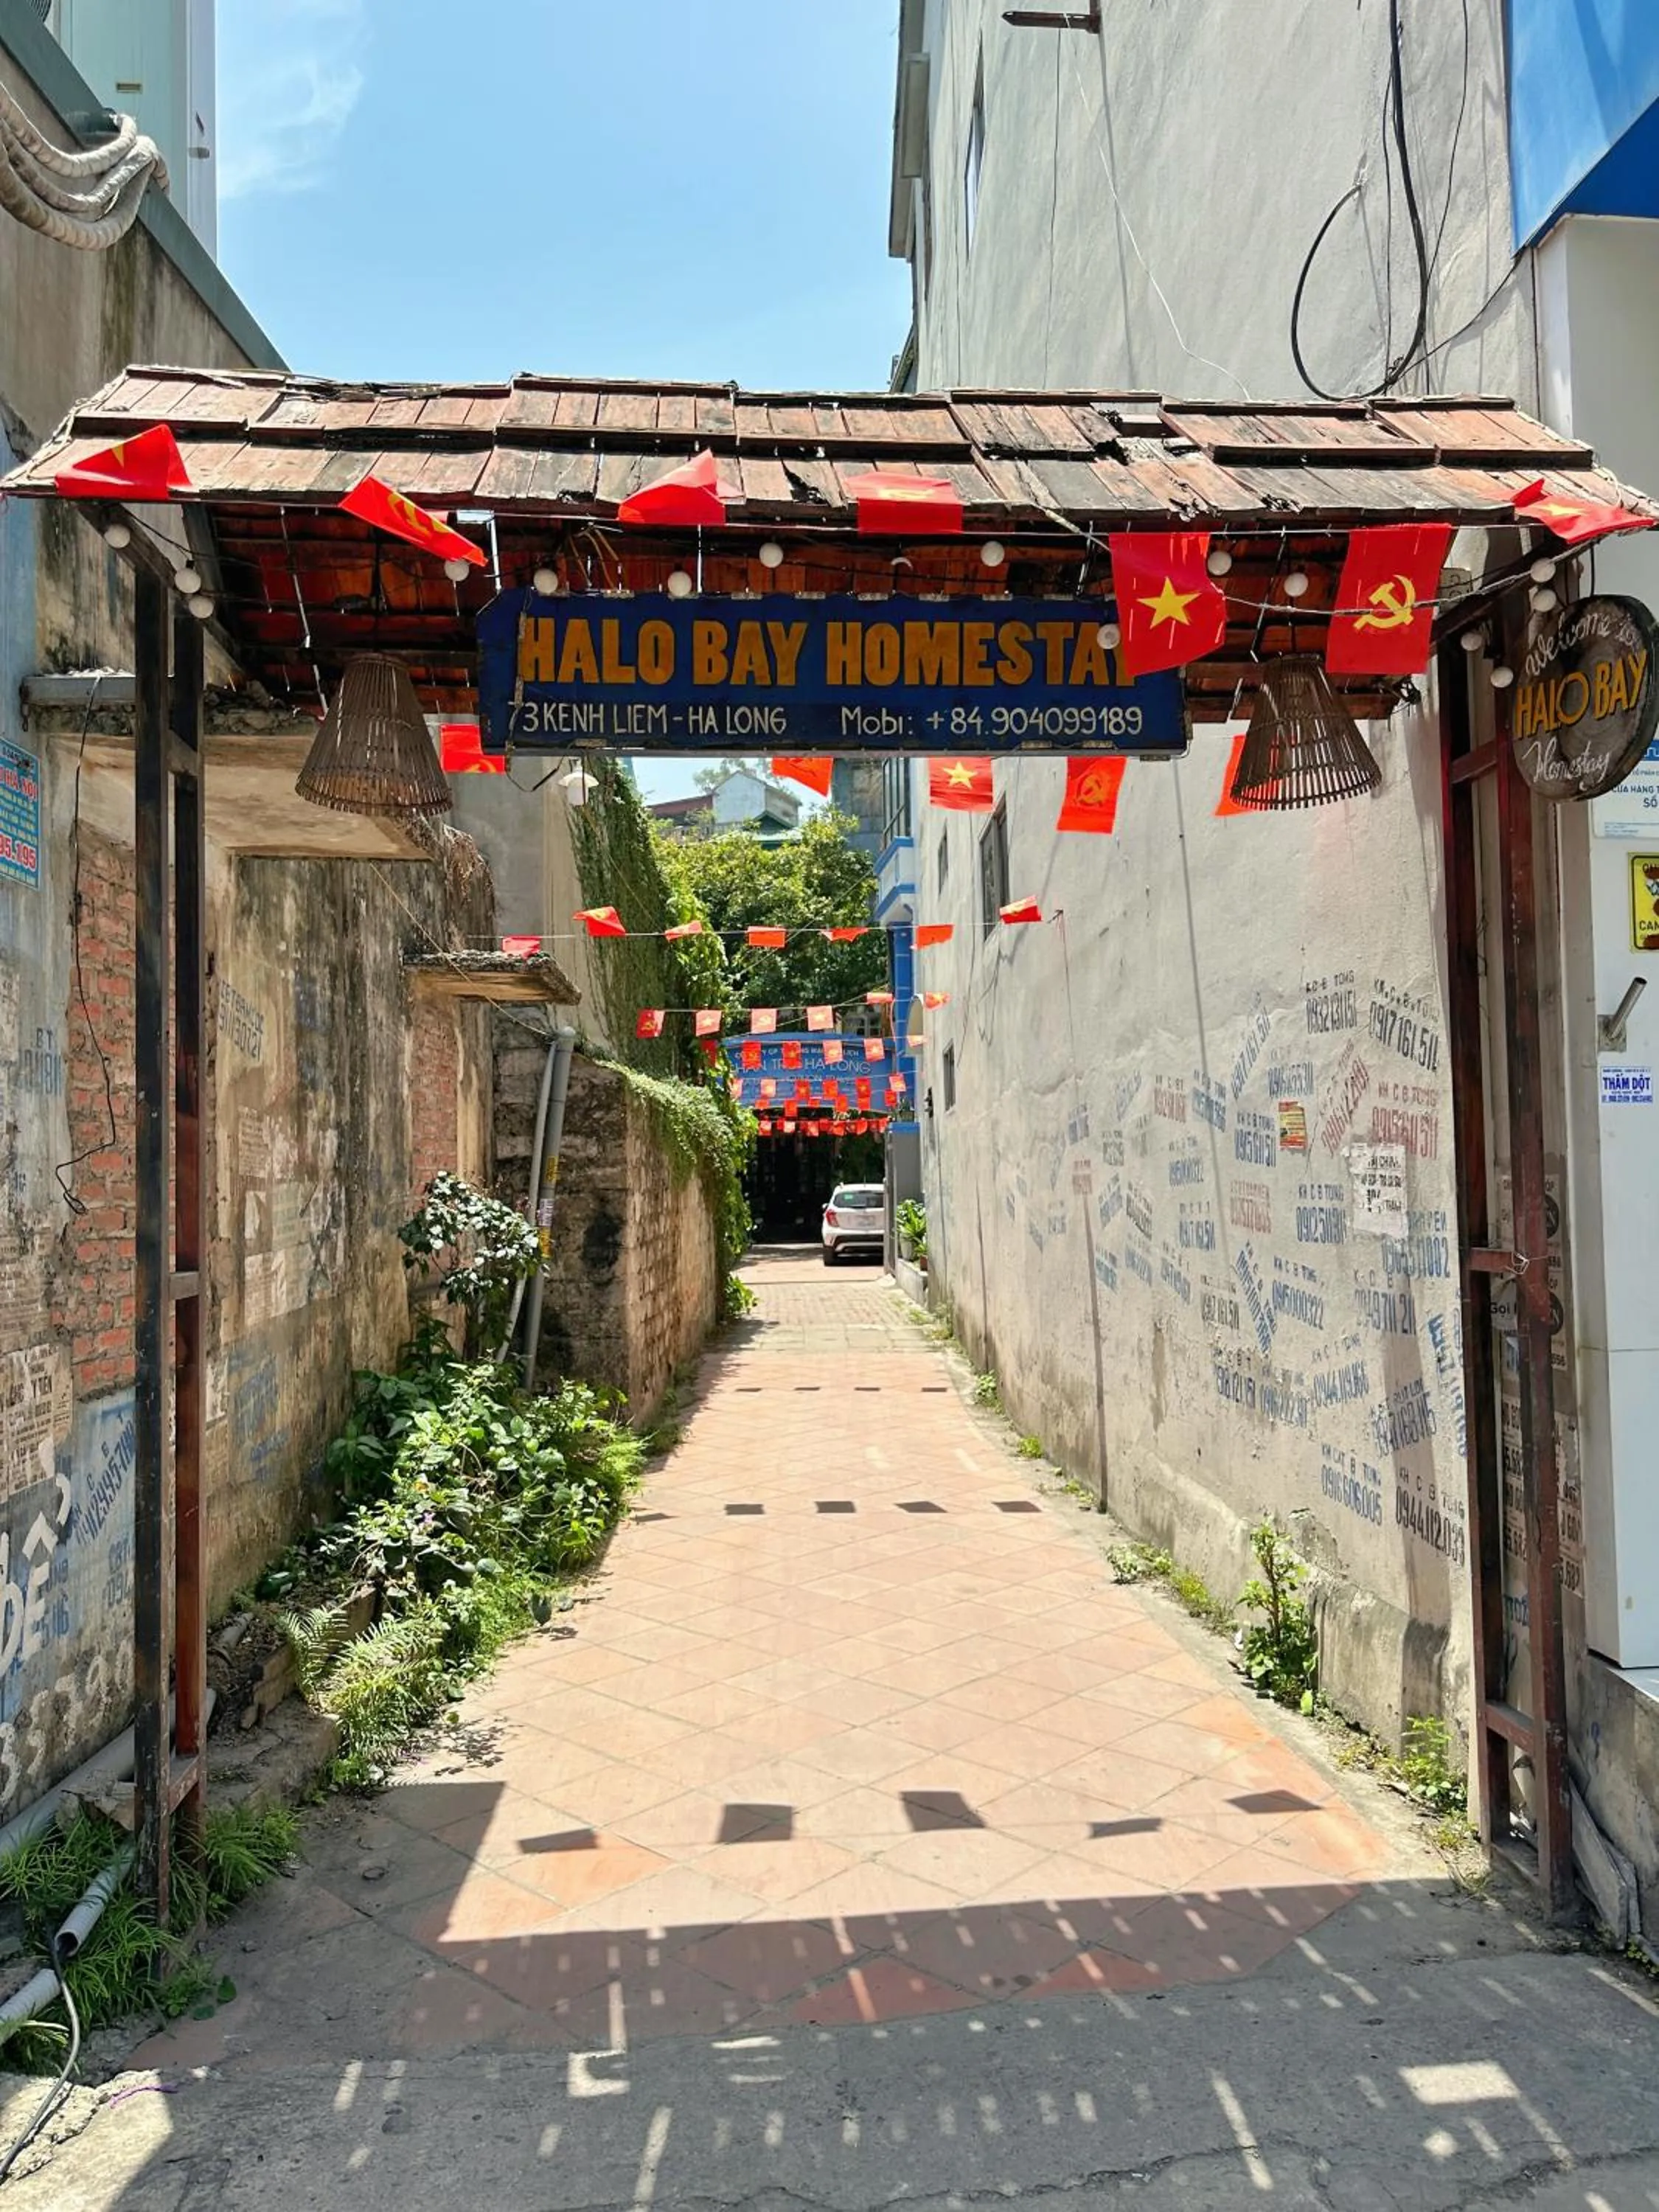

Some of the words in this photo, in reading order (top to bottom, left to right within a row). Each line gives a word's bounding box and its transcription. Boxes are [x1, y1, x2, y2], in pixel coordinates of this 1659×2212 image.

[520, 617, 675, 685] HALO
[693, 620, 808, 686] BAY
[543, 703, 604, 734] KENH
[726, 706, 787, 734] LONG
[841, 706, 913, 735] Mobi:
[1515, 672, 1590, 740] HALO
[1593, 648, 1647, 720] BAY
[1522, 737, 1611, 783] Homestay
